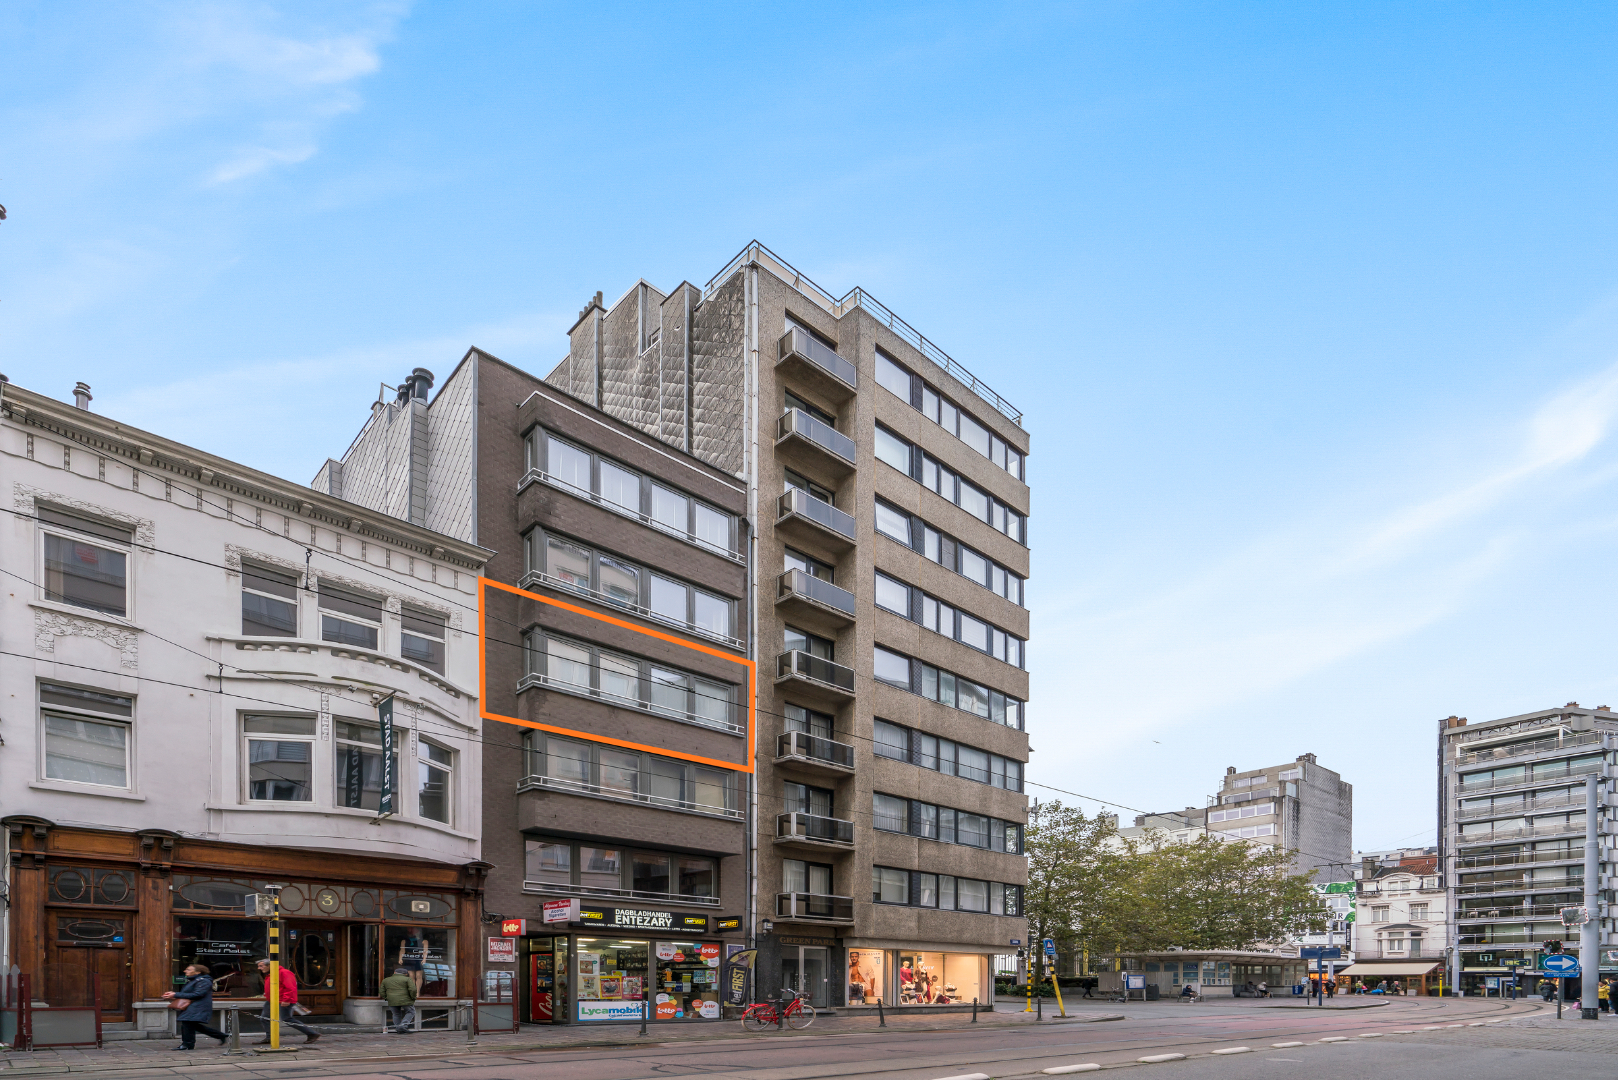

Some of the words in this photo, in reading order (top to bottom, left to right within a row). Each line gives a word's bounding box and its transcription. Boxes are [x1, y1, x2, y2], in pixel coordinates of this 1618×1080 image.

[322, 894, 333, 906] 3
[615, 908, 673, 918] DAGBLADHANDEL
[615, 914, 673, 927] ENTEZARY
[780, 936, 811, 945] GREEN
[812, 938, 836, 946] PARK
[731, 968, 745, 1004] betFIRST
